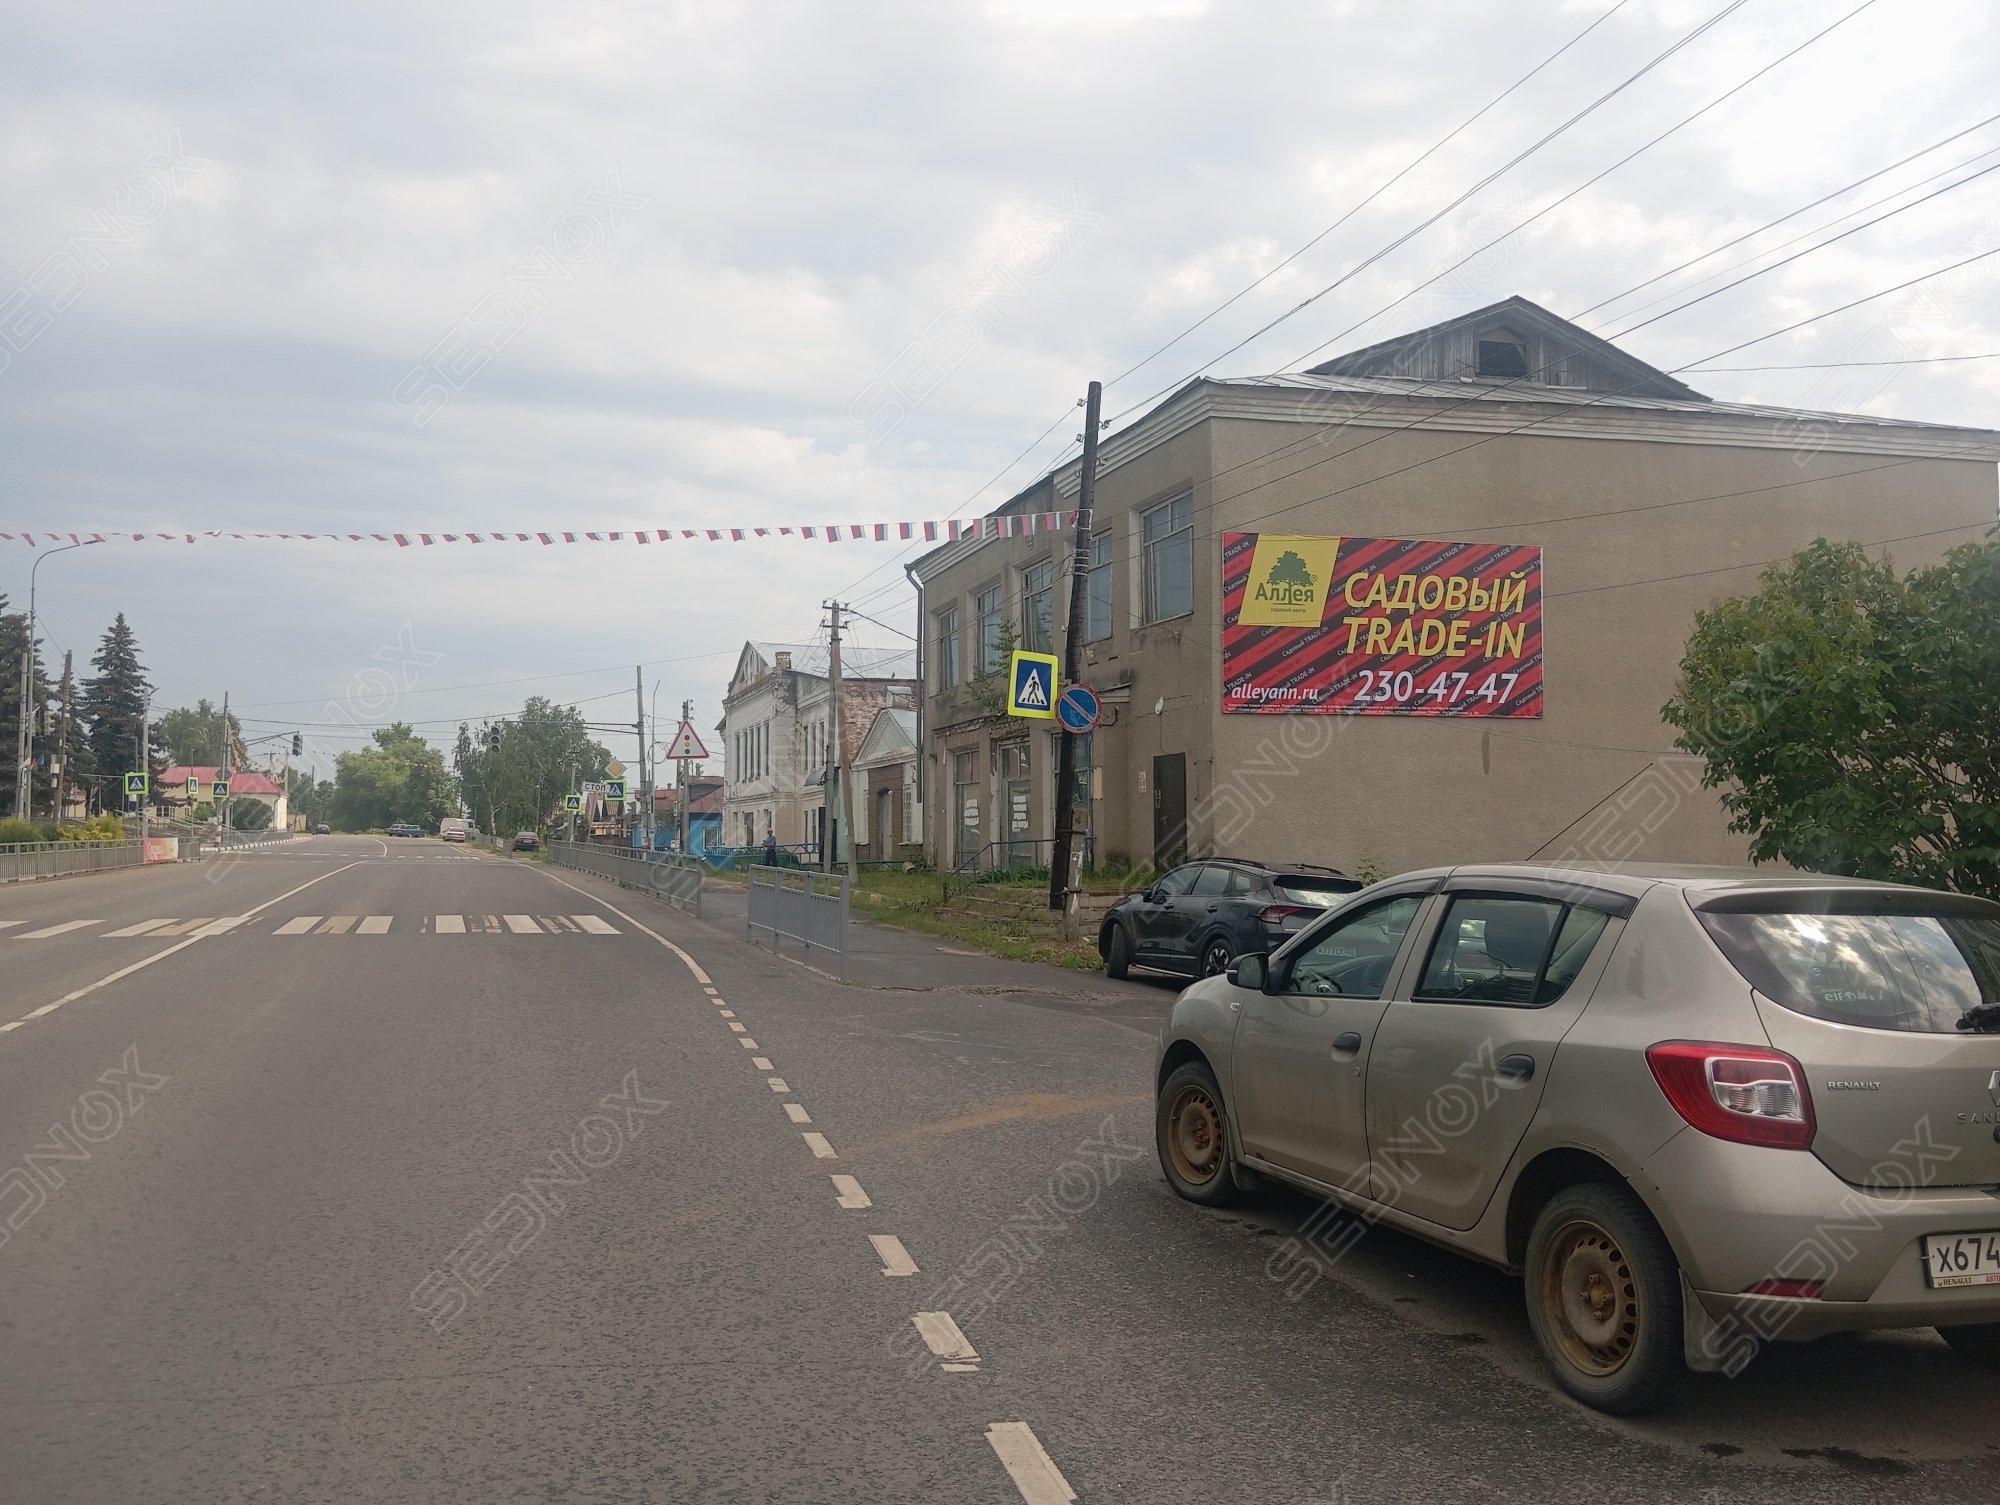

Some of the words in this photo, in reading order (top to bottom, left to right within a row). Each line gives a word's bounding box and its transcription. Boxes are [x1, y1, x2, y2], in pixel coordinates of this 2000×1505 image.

[1255, 583, 1314, 602] Аллея
[1344, 571, 1527, 615] САДОВЫЙ
[1343, 617, 1526, 658] TRADE-IN
[1231, 683, 1318, 703] alleyann.ru
[1354, 670, 1518, 704] 230-47-47
[1827, 1081, 1881, 1091] RENAULT
[1943, 1277, 1972, 1286] RENAULT
